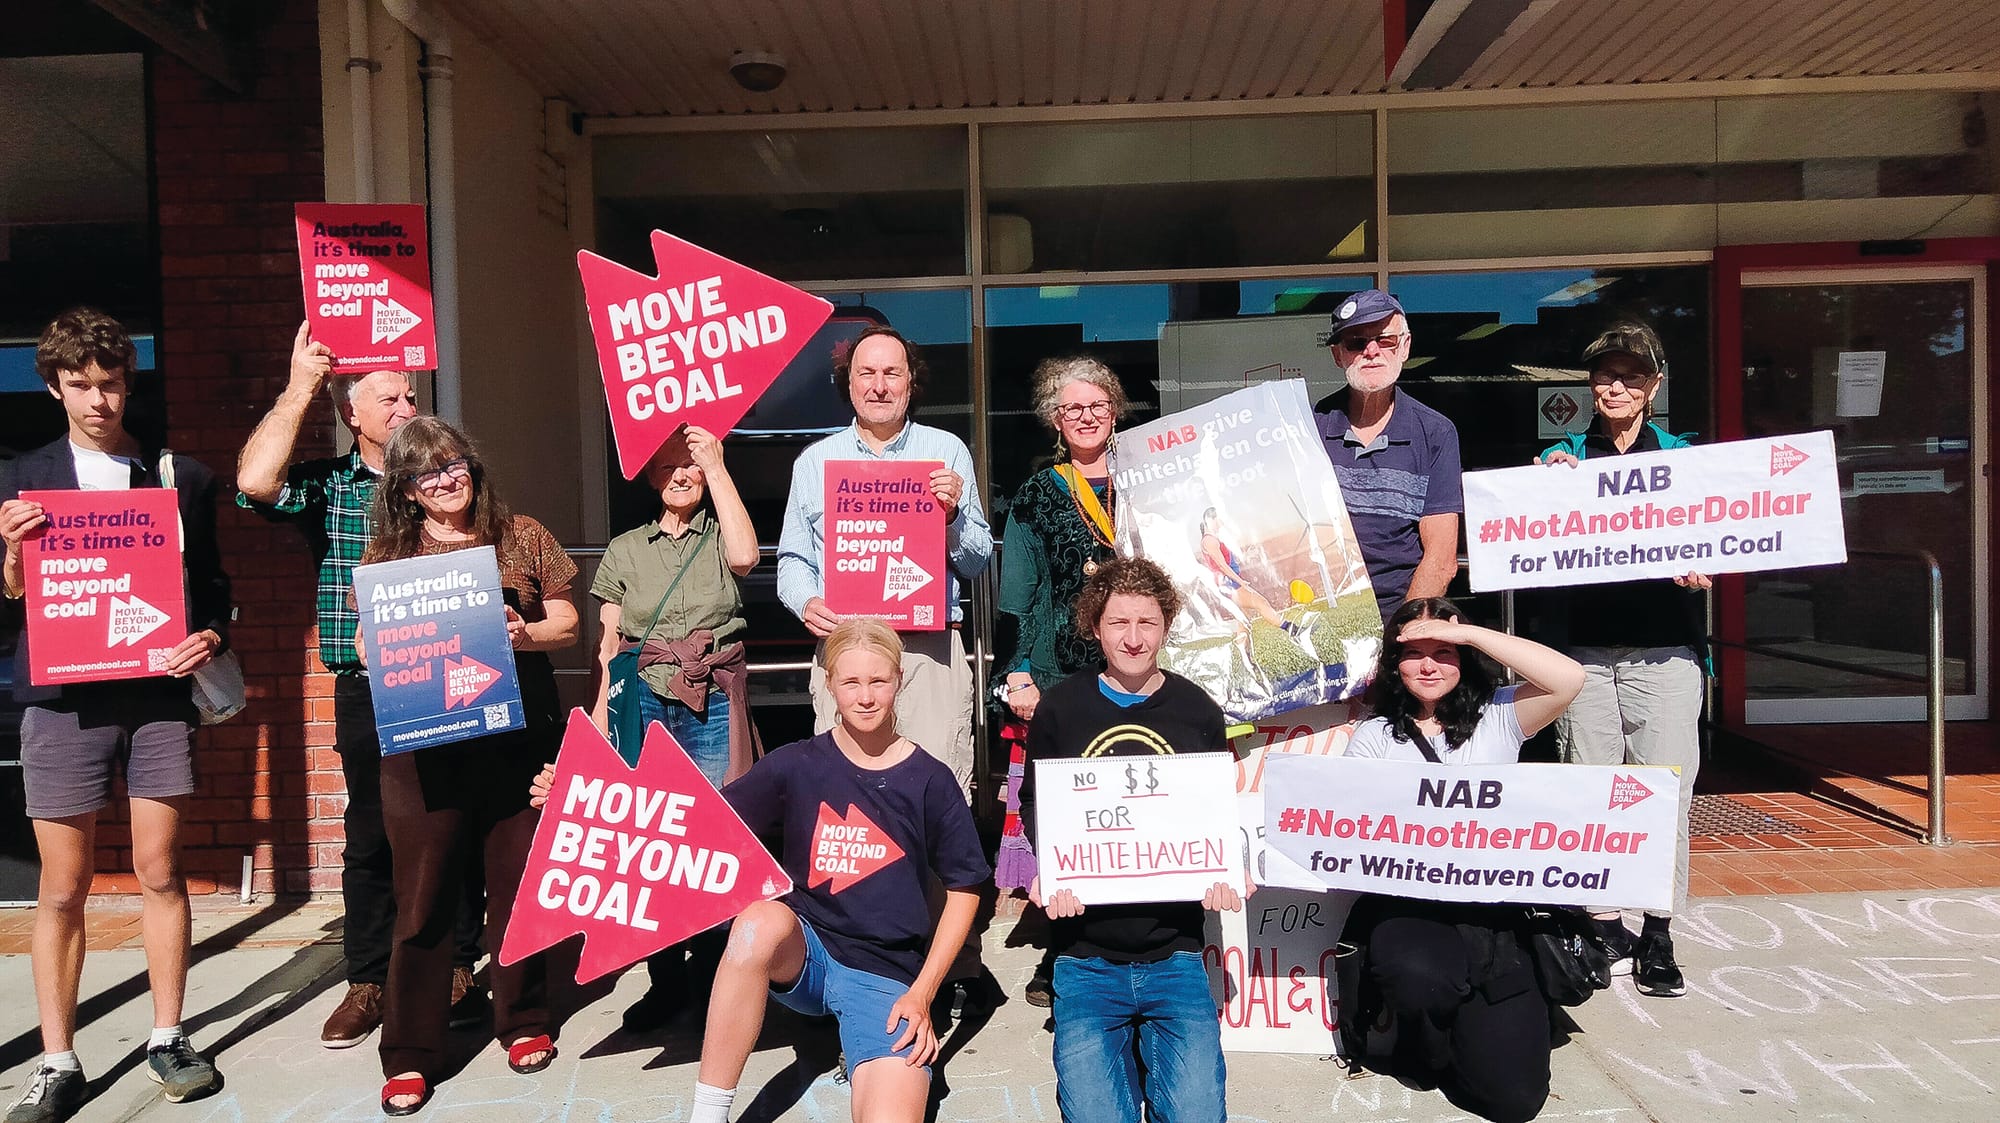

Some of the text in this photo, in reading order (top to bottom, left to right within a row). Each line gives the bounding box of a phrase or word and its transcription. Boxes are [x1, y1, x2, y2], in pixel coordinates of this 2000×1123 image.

[312, 221, 408, 239] Australia,
[314, 240, 416, 257] it's time to
[315, 263, 370, 278] move
[317, 279, 389, 301] beyond
[319, 299, 362, 317] coal
[377, 310, 401, 318] MOVE
[607, 275, 727, 341] MOVE
[376, 317, 412, 325] BEYOND
[376, 325, 401, 333] COAL
[616, 305, 787, 382] BEYOND
[626, 363, 743, 421] COAL
[1147, 409, 1252, 453] NAB give
[1773, 450, 1794, 458] MOVE
[1773, 455, 1803, 464] BEYOND
[836, 478, 927, 496] Australia,
[1598, 465, 1672, 498] NAB
[836, 497, 934, 513] it's time to
[40, 509, 156, 529] Australia,
[836, 519, 887, 533] move
[1479, 491, 1811, 544] #NotAnotherDollar
[40, 533, 165, 552] it's time to
[836, 536, 904, 557] beyond
[1510, 530, 1782, 574] for Whitehaven Coal
[40, 556, 107, 575] move
[836, 555, 877, 572] coal
[42, 573, 131, 600] beyond
[370, 569, 478, 603] Australia,
[44, 597, 97, 618] coal
[115, 607, 145, 617] MOVE
[373, 590, 489, 624] it's time to
[114, 615, 158, 626] BEYOND
[114, 625, 144, 635] COAL
[377, 620, 438, 645] move
[380, 634, 461, 667] beyond
[47, 659, 141, 674] movebeyondcoal.com
[383, 662, 432, 688] coal
[449, 665, 477, 678] MOVE
[449, 672, 491, 686] BEYOND
[449, 684, 478, 697] COAL
[393, 718, 479, 742] movebeyondcoal.com
[1074, 772, 1096, 787] NO
[1615, 782, 1638, 790] MOVE
[1417, 778, 1504, 809] NAB
[1614, 789, 1646, 797] BEYOND
[562, 774, 696, 837] MOVE
[1085, 806, 1132, 829] FOR
[821, 824, 869, 842] MOVE
[1277, 807, 1648, 855] #NotAnotherDollar
[549, 820, 740, 895] BEYOND
[817, 840, 887, 859] BEYOND
[1053, 838, 1224, 873] WHITEHAVEN
[815, 856, 860, 875] COAL
[1310, 850, 1610, 890] for Whitehaven Coal
[537, 868, 659, 932] COAL
[1259, 902, 1325, 935] FOR
